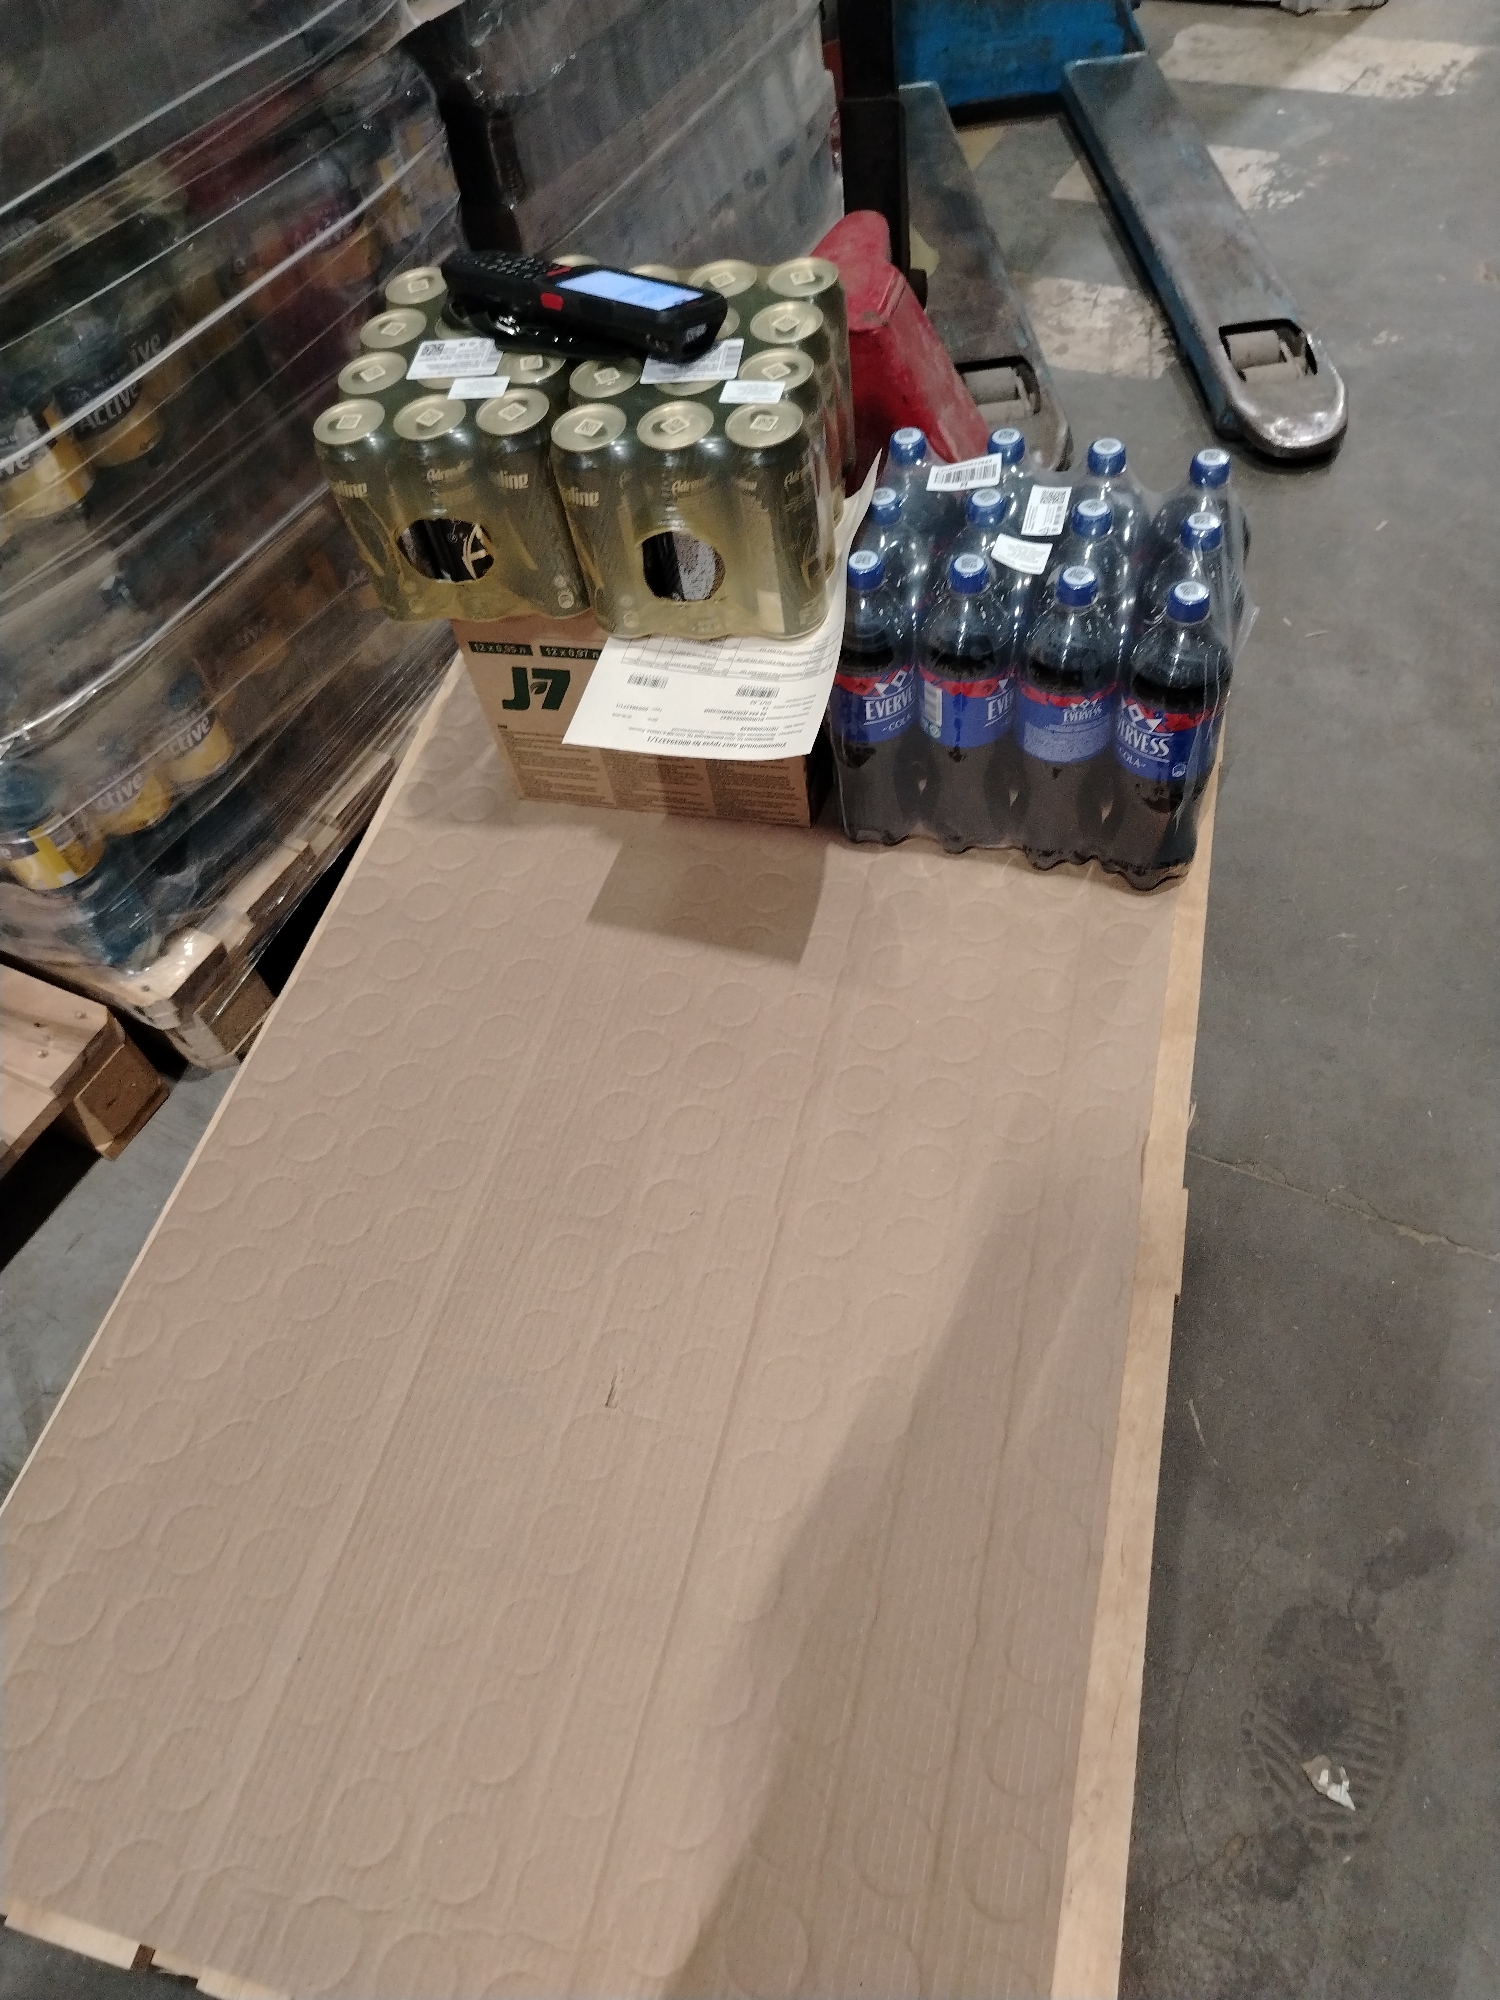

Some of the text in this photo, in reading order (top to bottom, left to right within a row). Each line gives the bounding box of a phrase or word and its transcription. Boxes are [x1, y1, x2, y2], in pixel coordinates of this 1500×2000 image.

[474, 643, 485, 652] 12
[545, 647, 558, 656] 12
[502, 667, 571, 711] J7
